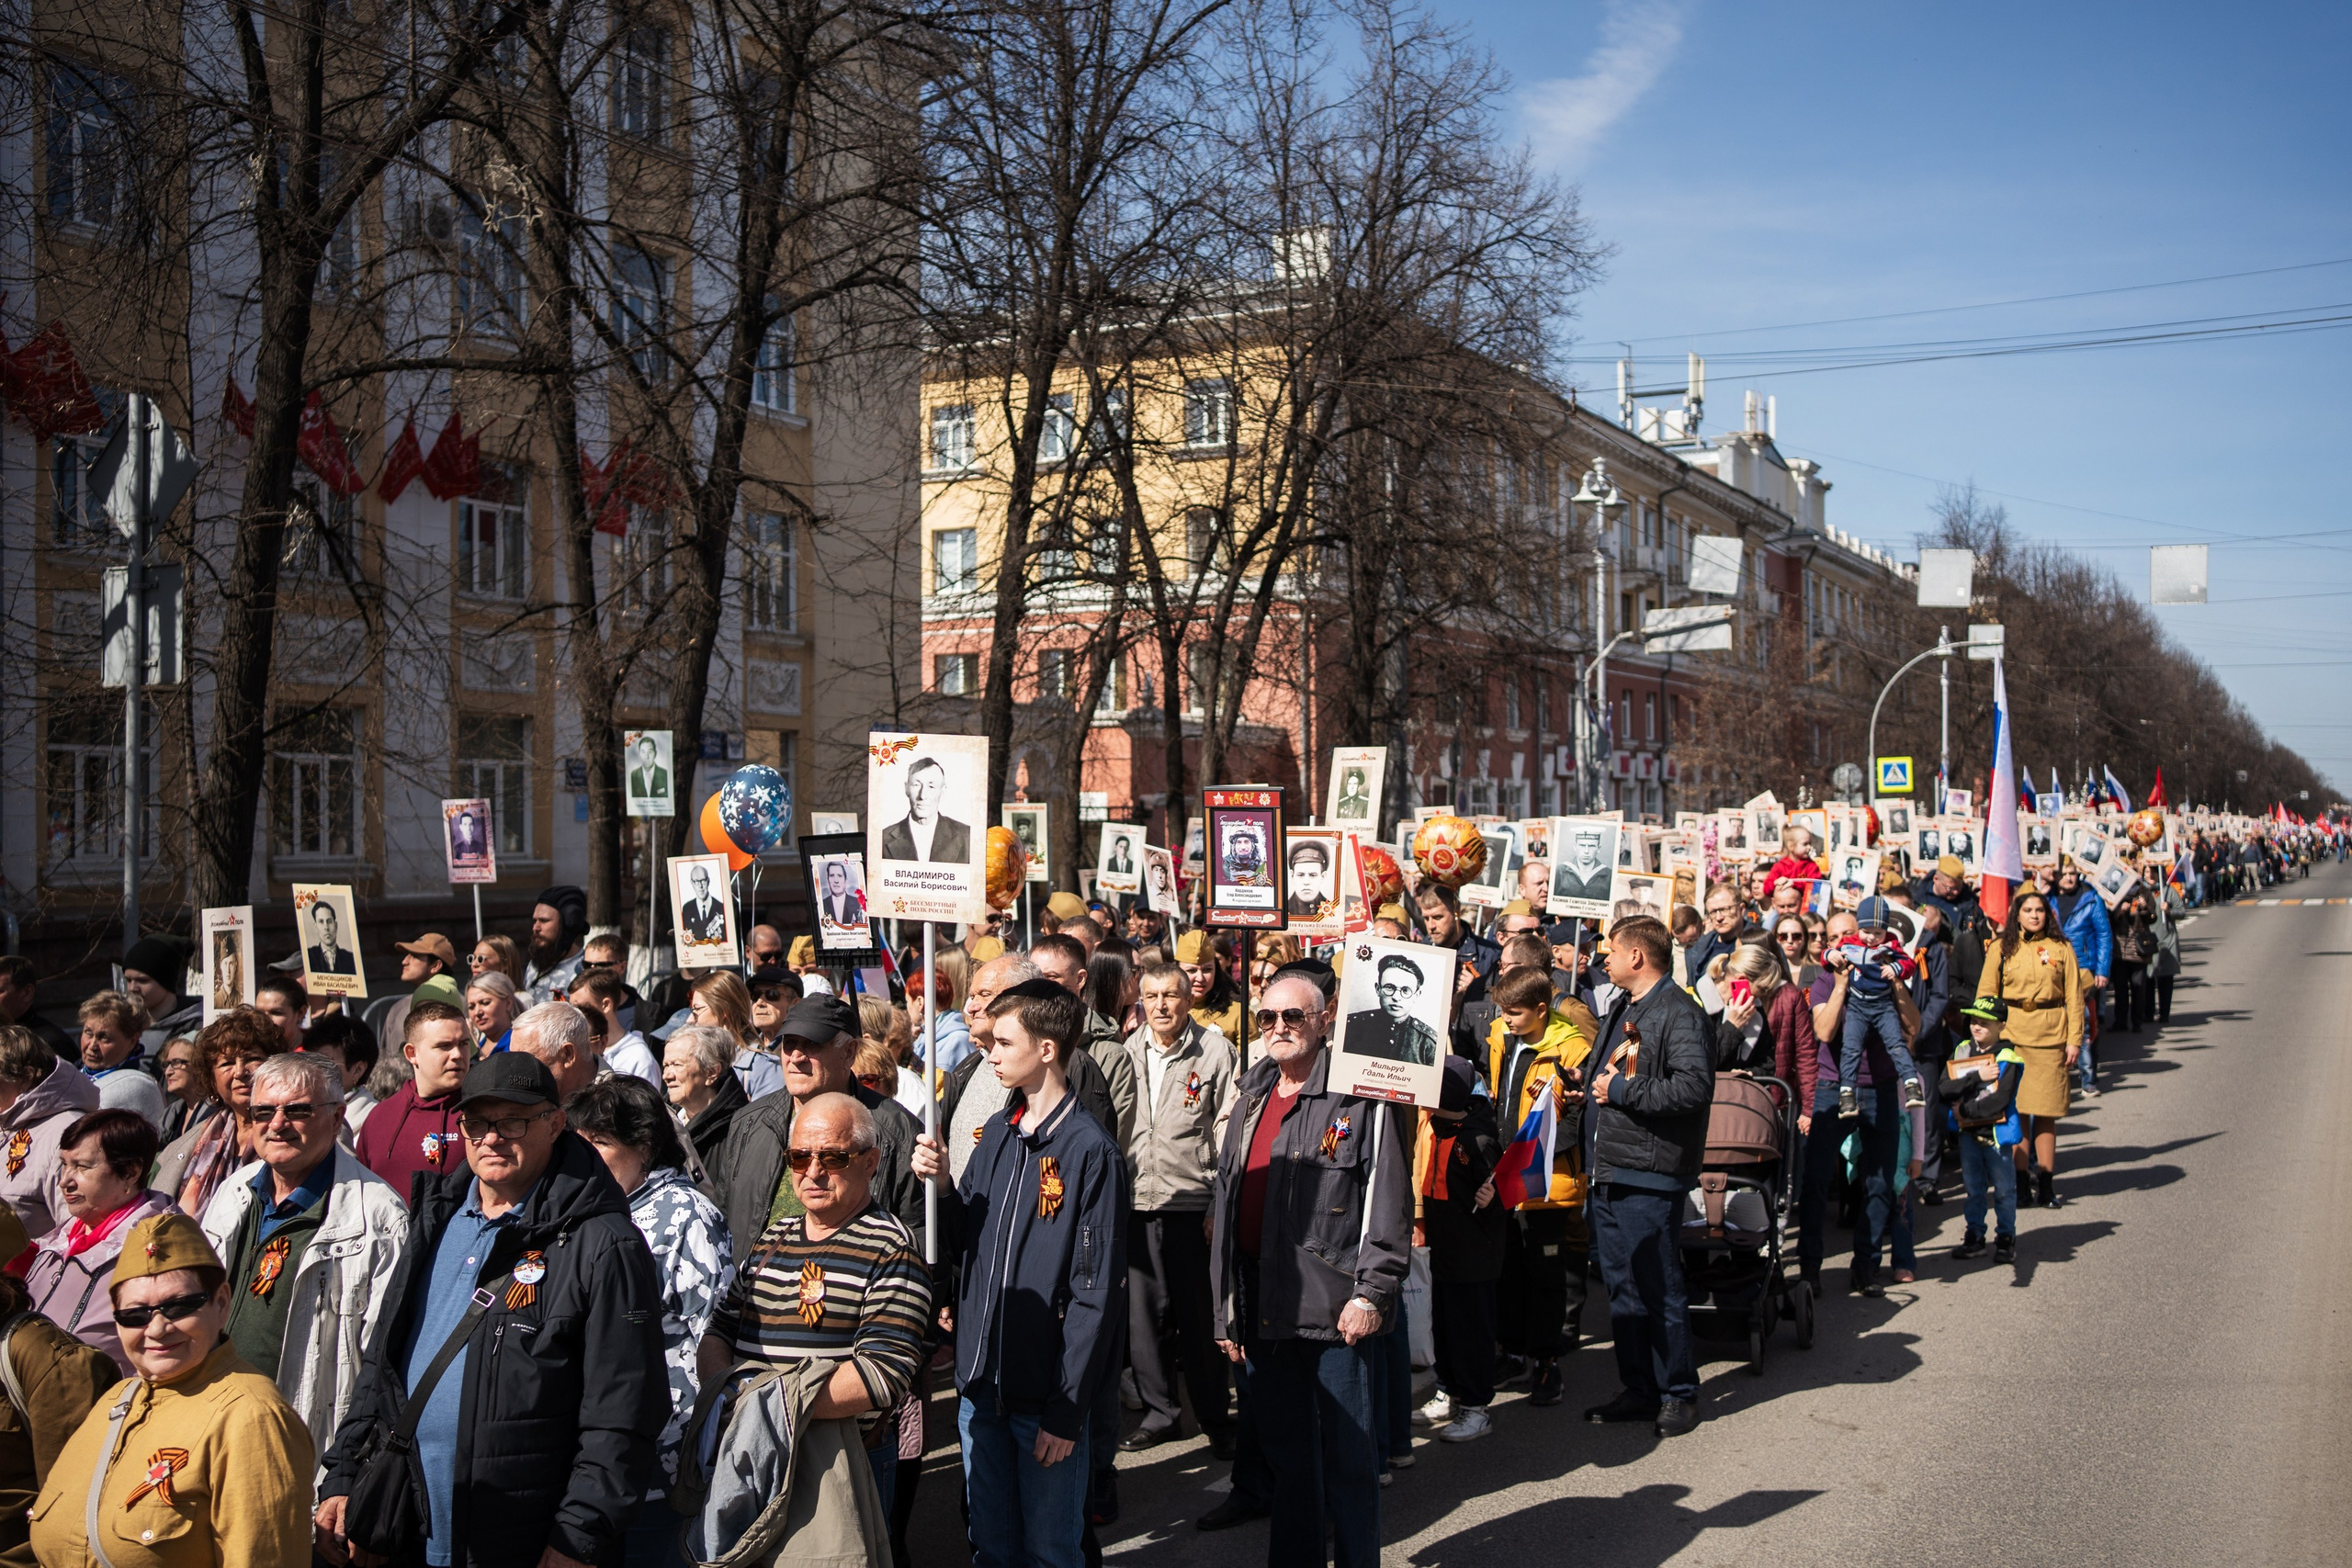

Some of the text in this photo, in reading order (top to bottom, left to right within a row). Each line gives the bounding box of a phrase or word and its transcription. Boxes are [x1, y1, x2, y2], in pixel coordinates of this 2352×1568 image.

[1353, 825, 1374, 833] Петрович
[895, 869, 956, 881] ВЛАДИМИРОВ
[884, 878, 967, 891] Василий Борисович
[910, 899, 956, 908] БЕССМЕРТНЫЙ
[1371, 1061, 1405, 1072] Мильруд
[508, 1075, 533, 1087] SPORT
[1362, 1068, 1411, 1082] Гдаль Ильич
